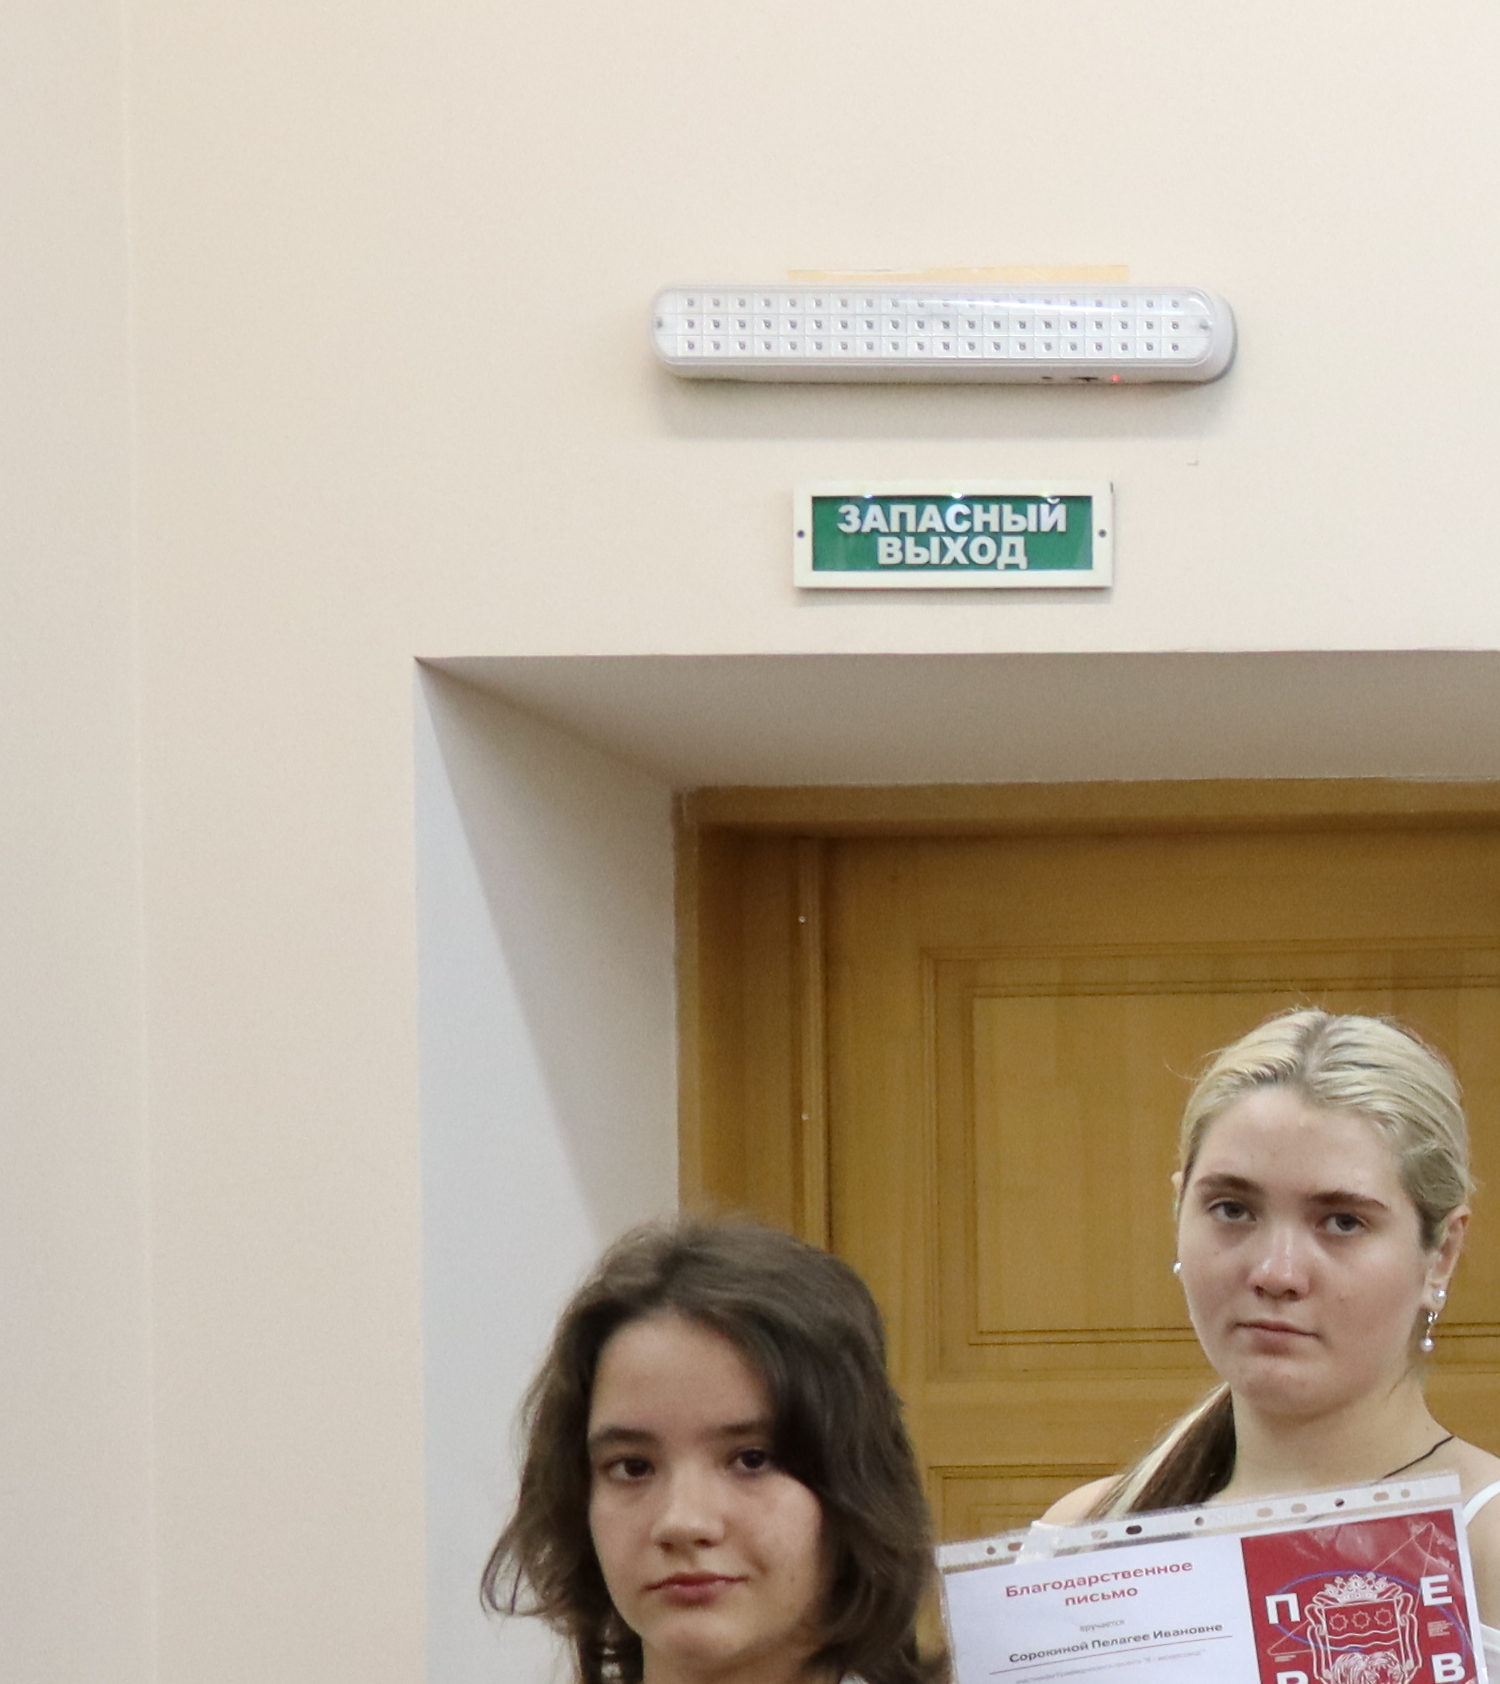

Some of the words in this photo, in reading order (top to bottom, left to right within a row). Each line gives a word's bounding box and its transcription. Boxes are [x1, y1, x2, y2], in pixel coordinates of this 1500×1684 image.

[836, 496, 1067, 534] ЗАПАСНЫЙ
[877, 536, 1028, 570] ВЫХОД
[1004, 1560, 1195, 1598] Благодарственное
[1063, 1585, 1140, 1607] письмо
[1264, 1592, 1300, 1624] П
[1420, 1573, 1453, 1607] Е
[1007, 1641, 1089, 1664] Сорокиной
[1090, 1632, 1151, 1650] Пелагее
[1152, 1621, 1223, 1641] Ивановне
[1431, 1651, 1467, 1684] В
